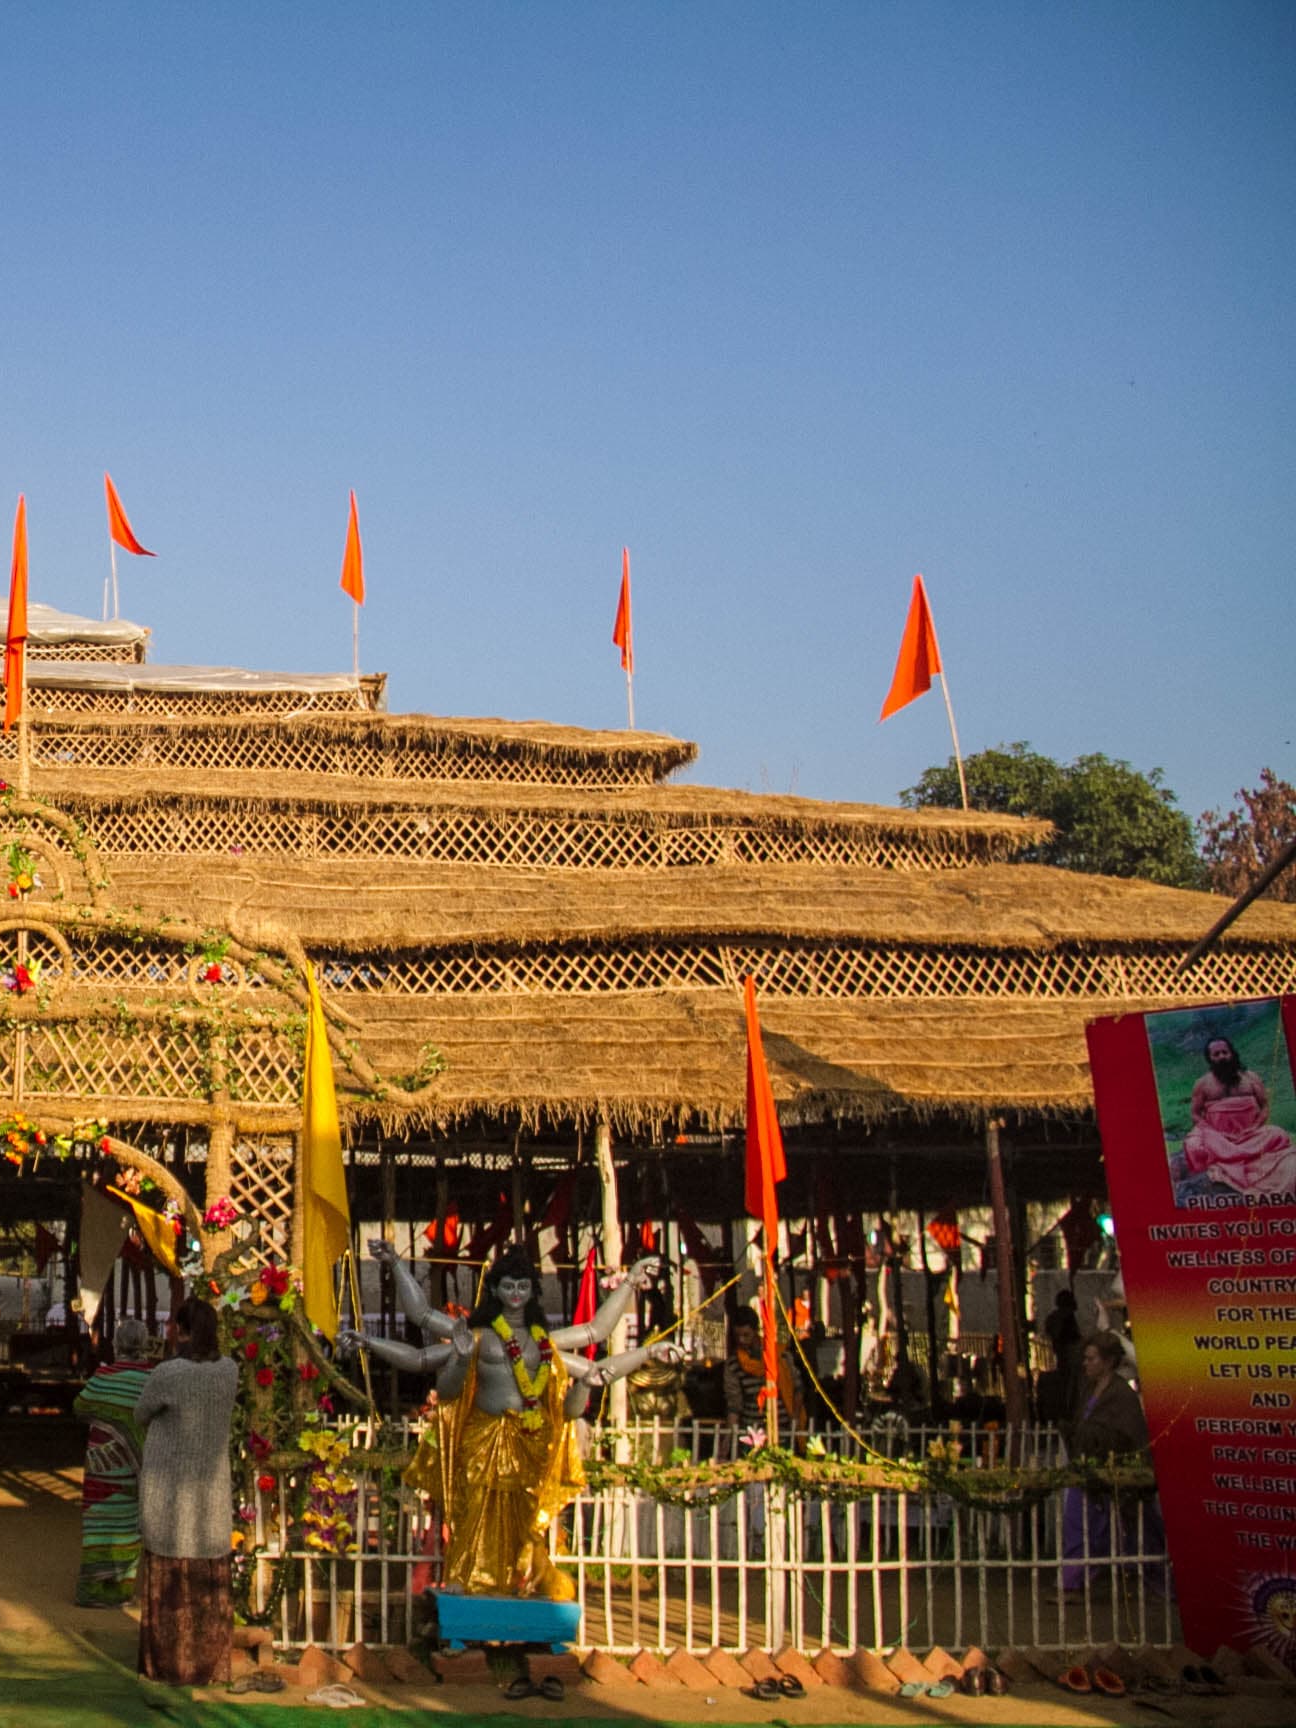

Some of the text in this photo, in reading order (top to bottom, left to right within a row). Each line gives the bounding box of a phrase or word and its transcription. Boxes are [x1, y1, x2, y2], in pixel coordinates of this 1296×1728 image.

[1187, 1191, 1296, 1210] PILOT BABA
[1149, 1223, 1220, 1240] INVITES
[1225, 1221, 1263, 1237] YOU
[1167, 1249, 1296, 1267] WELLNESS OF
[1209, 1278, 1296, 1295] COUNTRY
[1216, 1307, 1296, 1321] FOR THE
[1193, 1335, 1260, 1350] WORLD
[1209, 1363, 1241, 1378] LET
[1247, 1364, 1273, 1378] US
[1251, 1392, 1291, 1408] AND
[1196, 1419, 1282, 1436] PERFORM
[1213, 1446, 1257, 1462] PRAY
[1214, 1474, 1296, 1494] WELLBEI
[1205, 1501, 1238, 1517] THE
[1236, 1531, 1296, 1551] THE W
